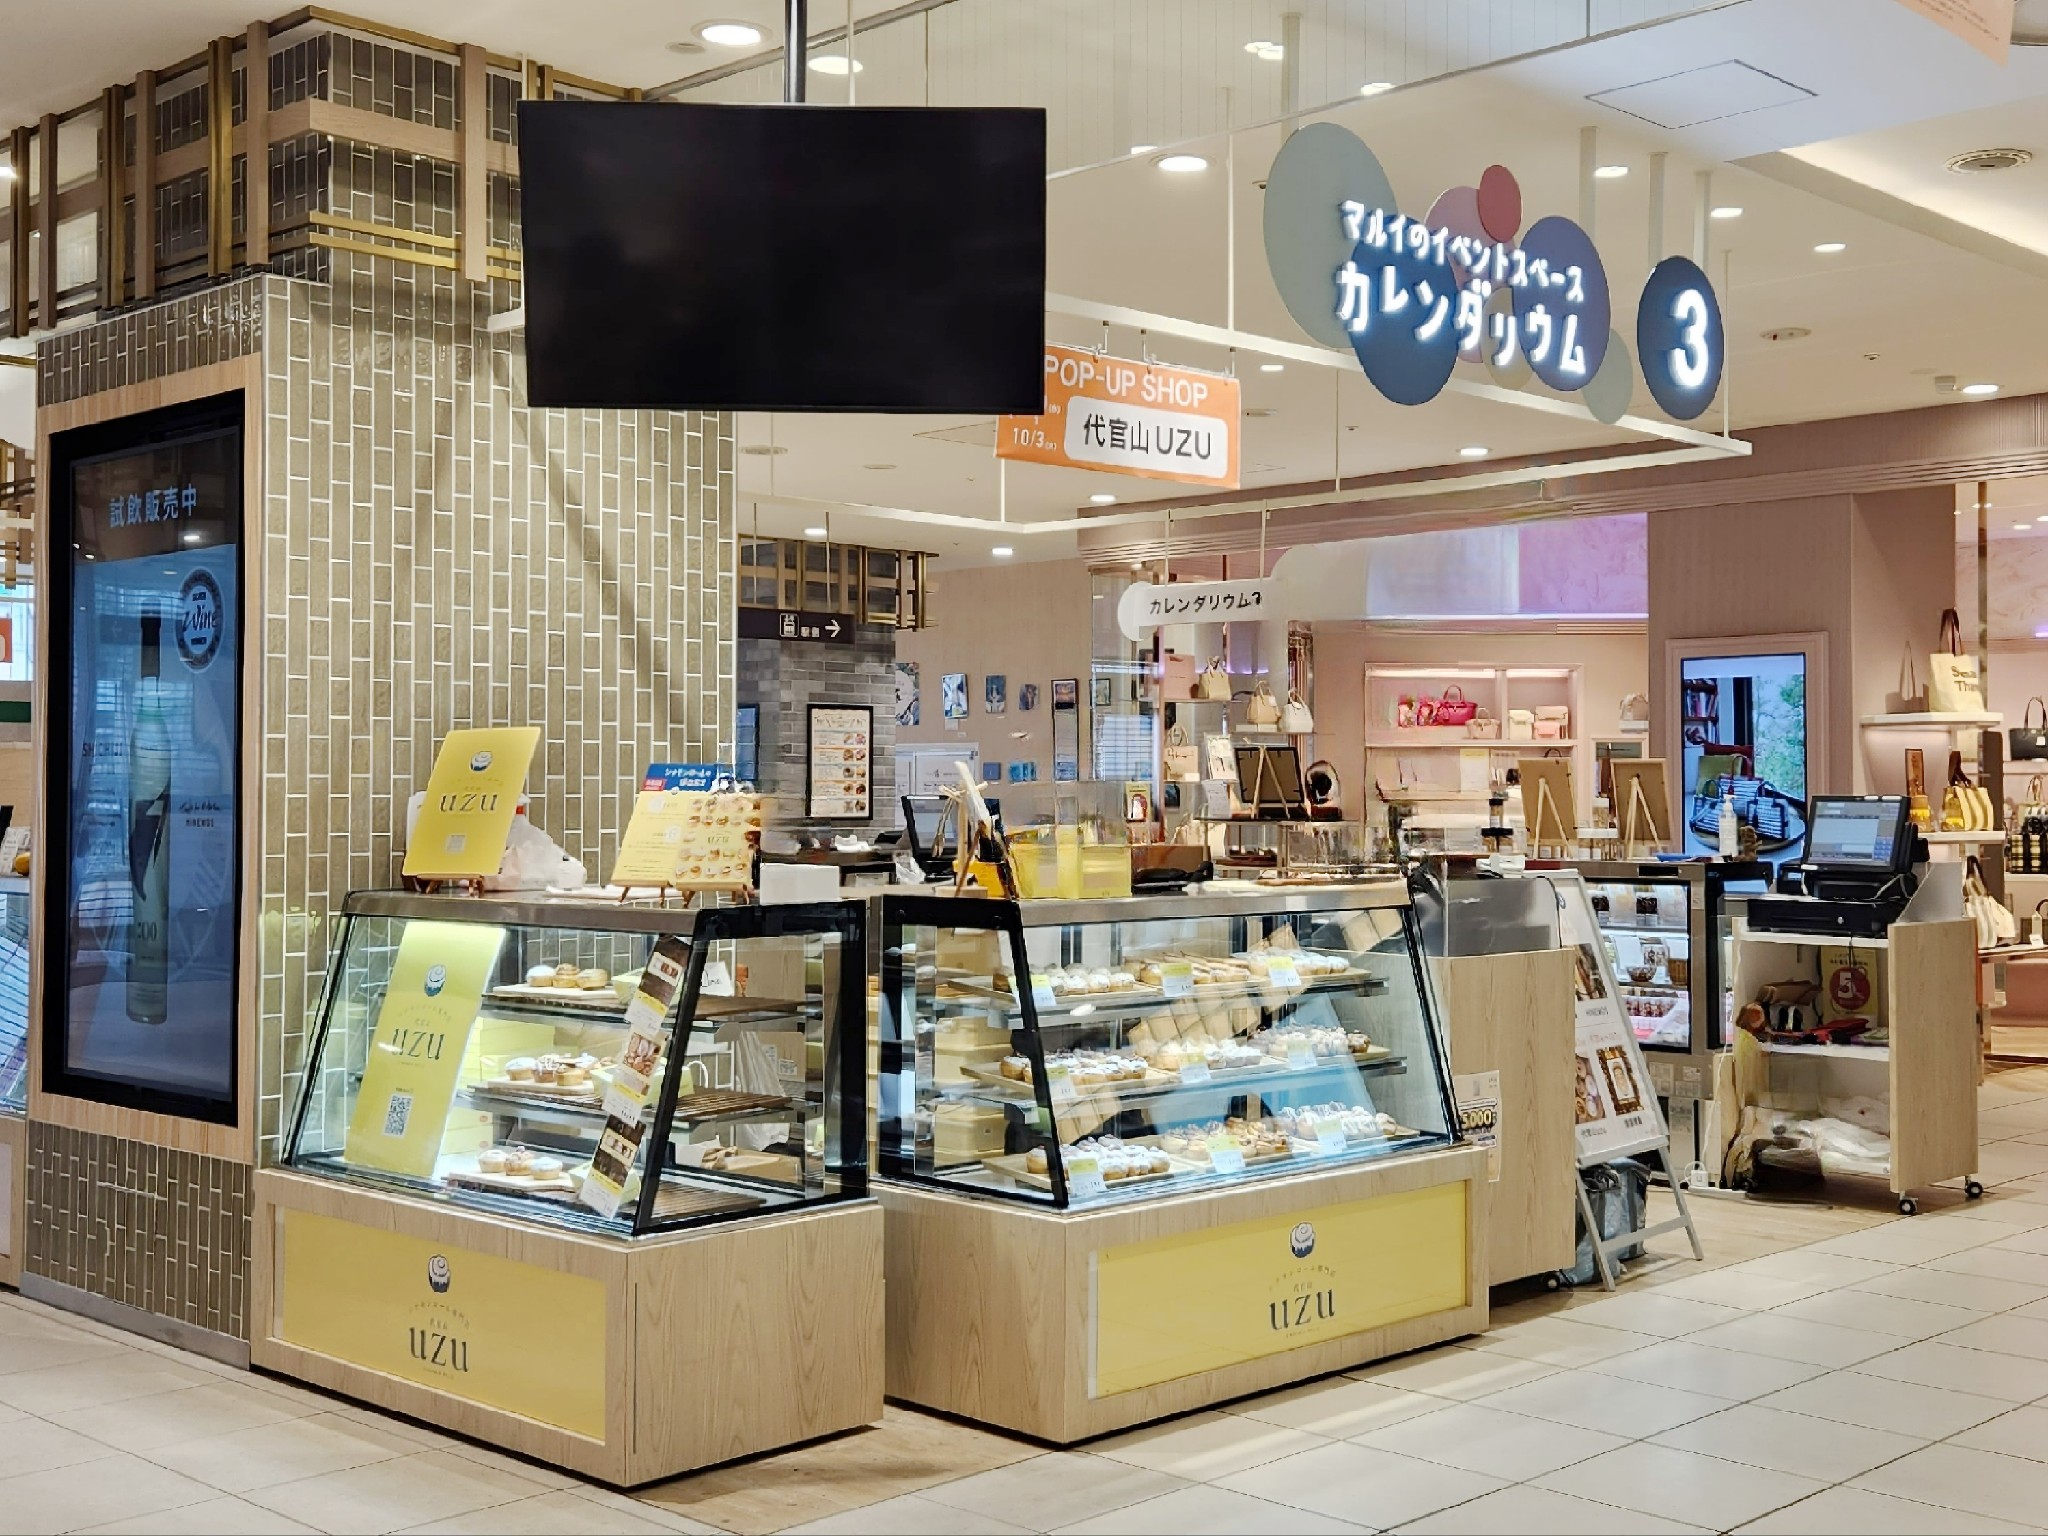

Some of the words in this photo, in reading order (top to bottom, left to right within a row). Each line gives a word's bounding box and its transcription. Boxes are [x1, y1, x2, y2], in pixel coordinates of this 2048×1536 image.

[1341, 199, 1584, 302] マルイのイベントスペース
[1336, 260, 1586, 374] カレンダリウム
[1669, 288, 1709, 386] 3
[1044, 354, 1136, 397] POP-UP
[1141, 374, 1209, 409] SHOP
[108, 482, 198, 529] 試飲販売中
